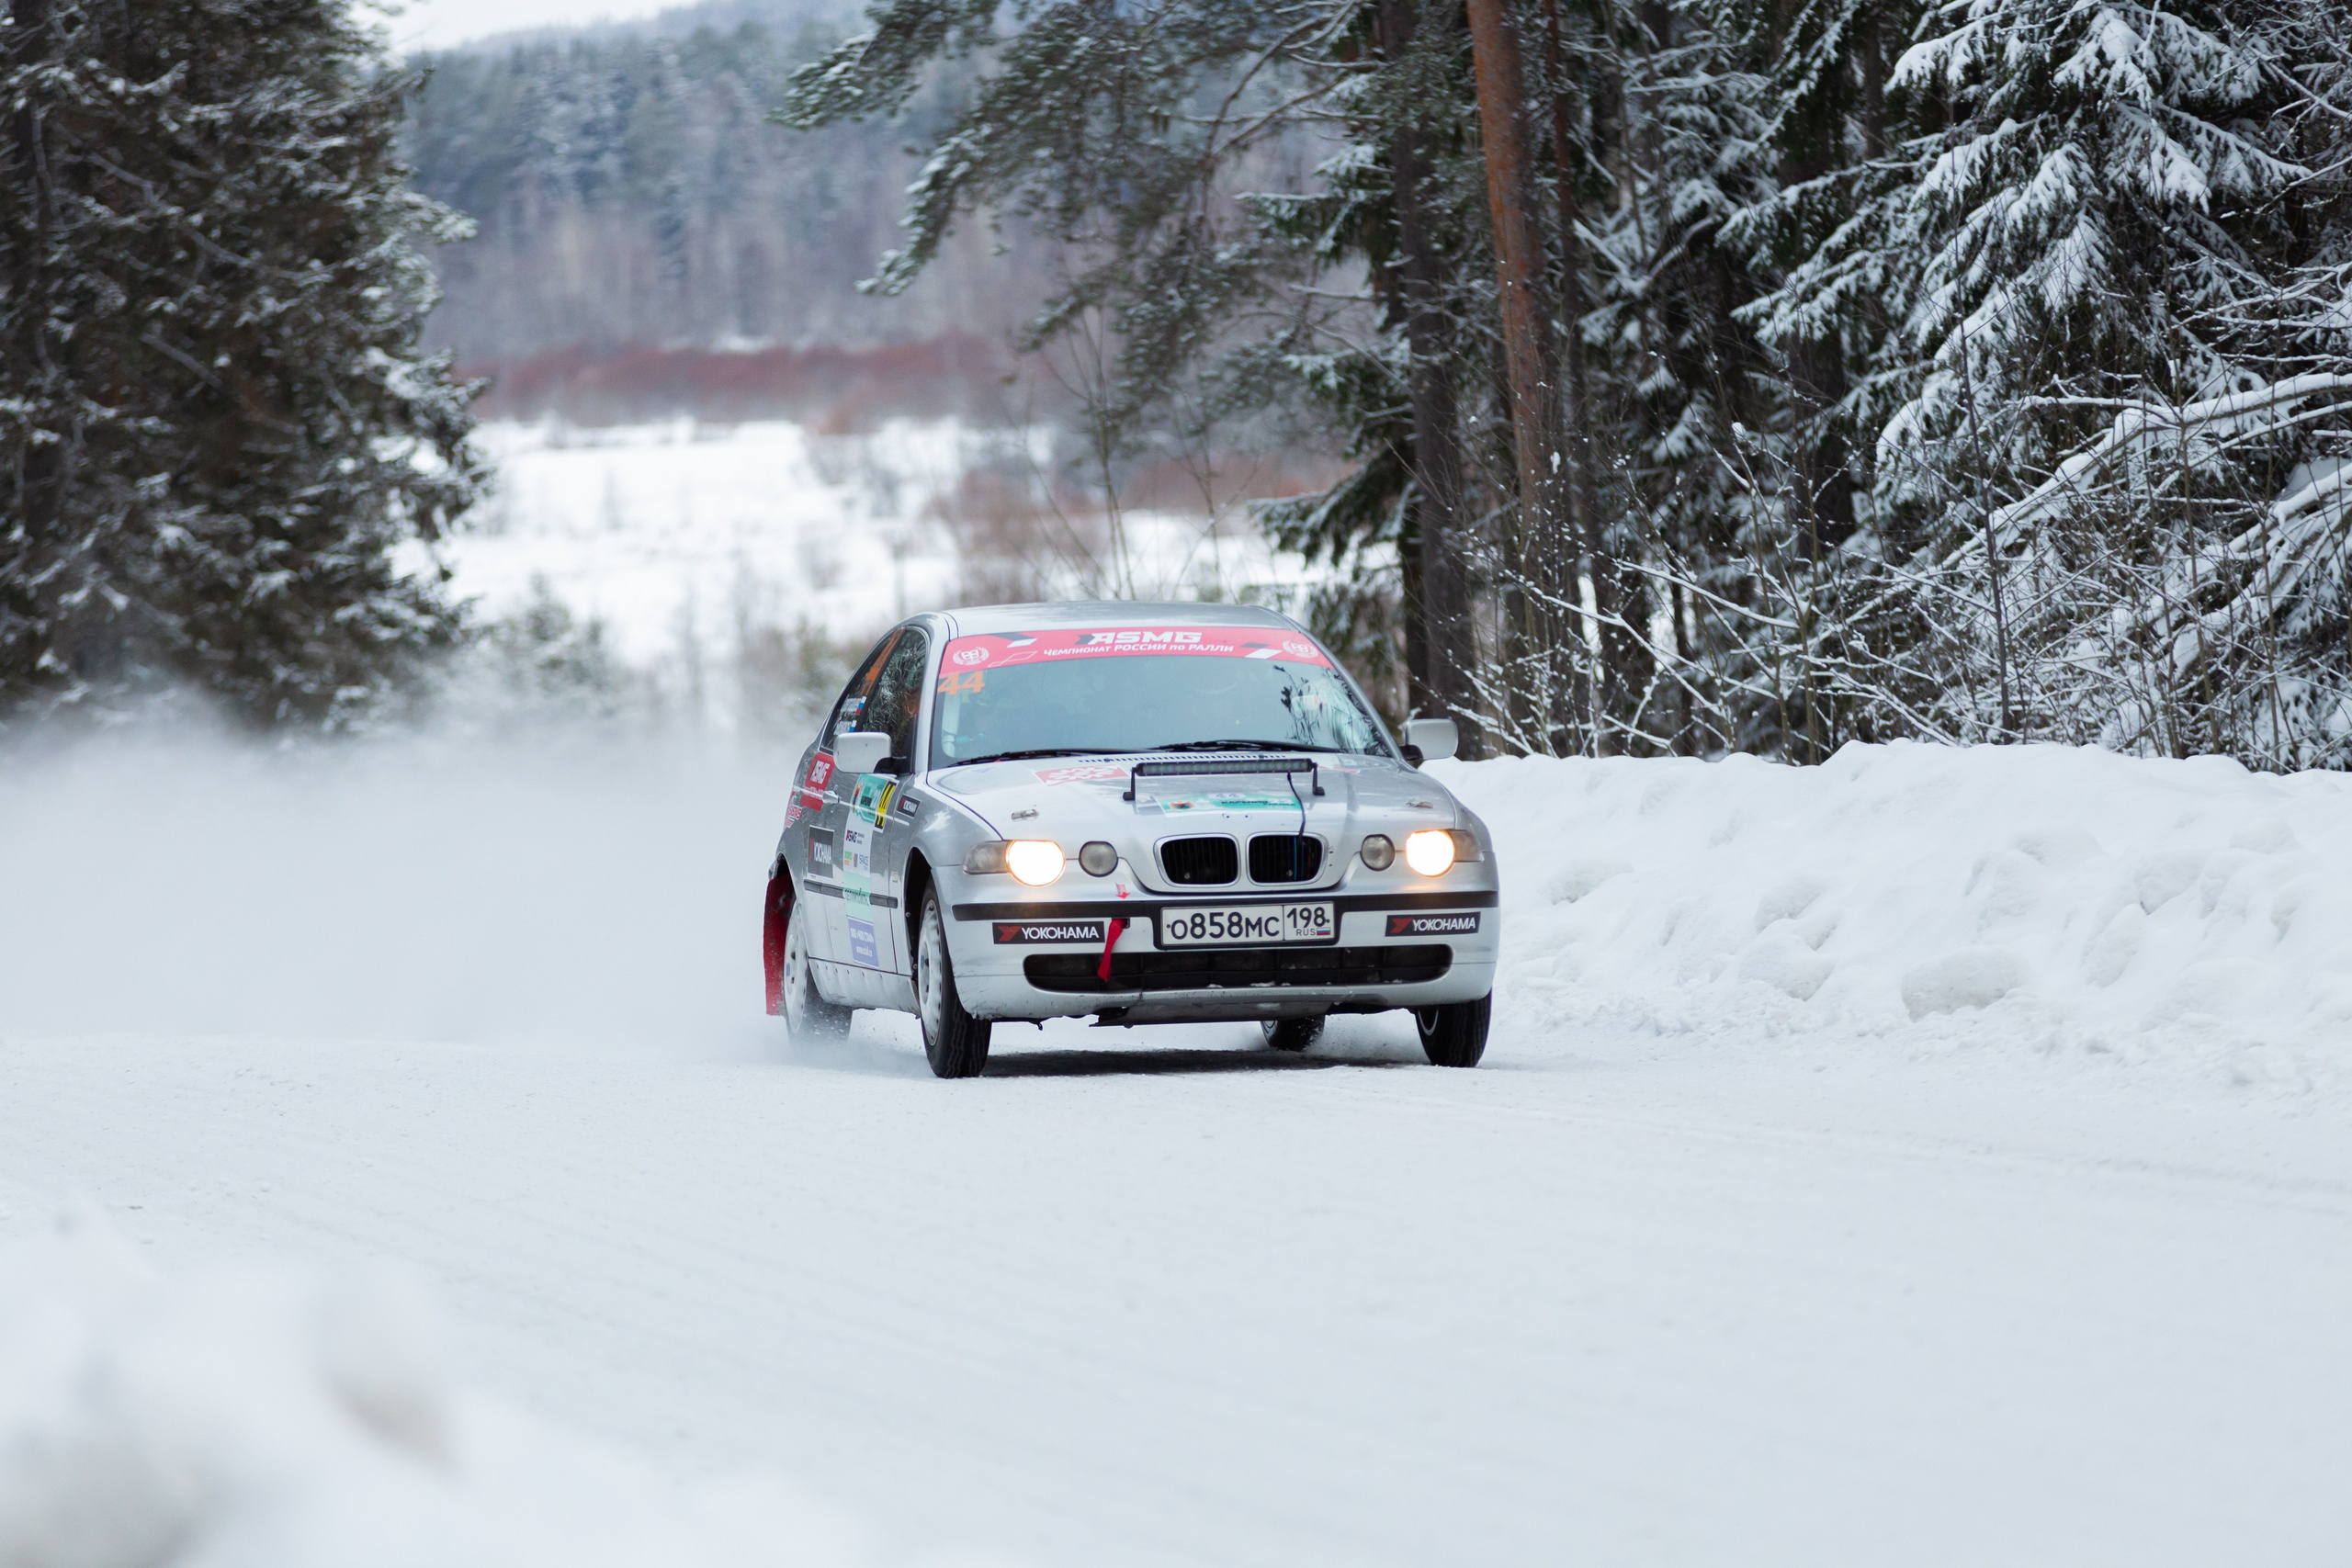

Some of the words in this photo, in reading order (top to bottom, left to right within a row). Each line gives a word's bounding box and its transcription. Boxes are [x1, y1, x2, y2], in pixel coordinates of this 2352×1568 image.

[1086, 630, 1203, 645] ASMG
[1043, 645, 1113, 657] ЧЕМПИОНАТ
[1114, 643, 1167, 653] РОССИИ
[1188, 643, 1235, 653] РАЛЛИ
[936, 671, 986, 696] 44
[1286, 906, 1326, 929] 198
[1412, 917, 1476, 931] YOKOHAMA
[1021, 926, 1100, 940] YOKOHAMA
[1295, 928, 1317, 937] RUS
